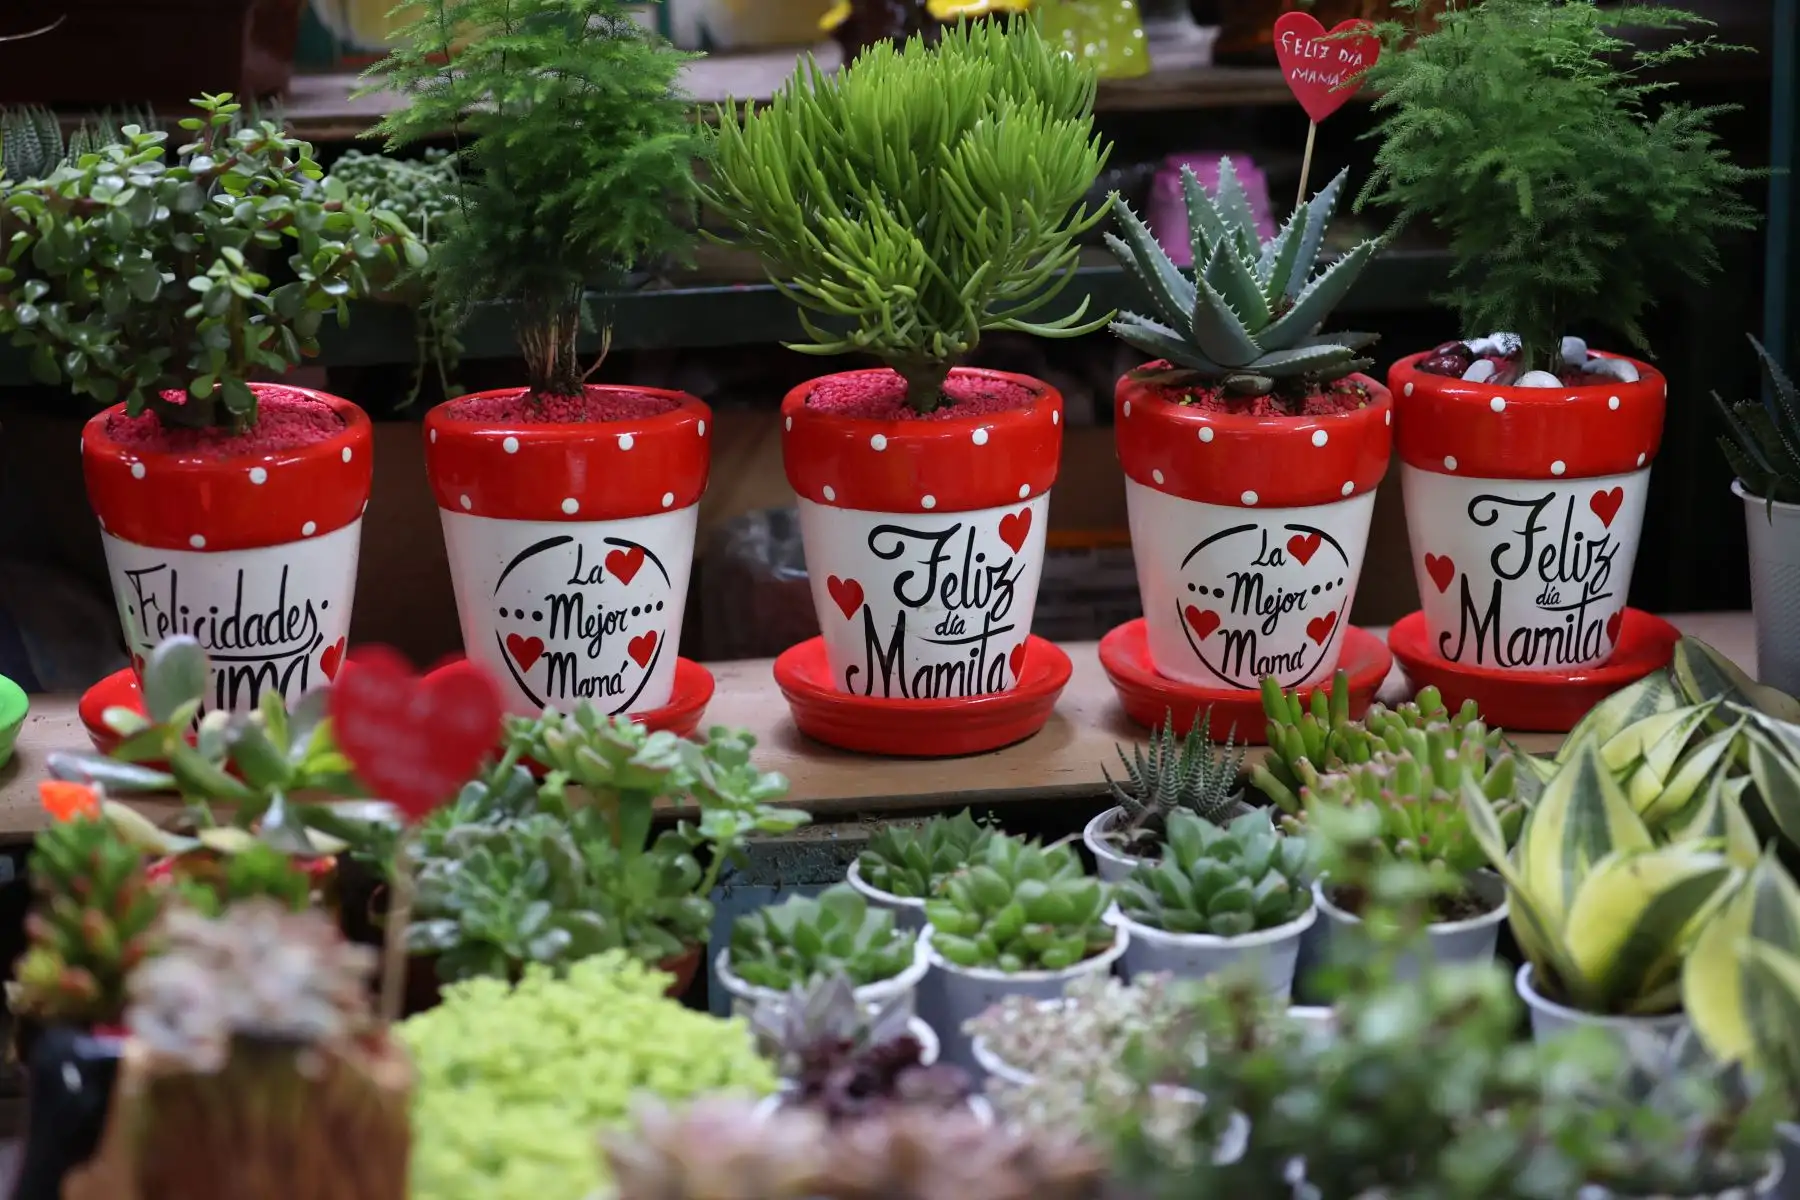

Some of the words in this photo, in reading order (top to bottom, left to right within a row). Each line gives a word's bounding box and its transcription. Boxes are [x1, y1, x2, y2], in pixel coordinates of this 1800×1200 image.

[1281, 31, 1330, 58] FELIZ
[567, 543, 605, 585] La
[1250, 528, 1287, 567] La
[1467, 491, 1621, 595] Feliz
[867, 522, 1026, 622] Feliz
[1535, 583, 1562, 606] día
[125, 564, 318, 656] Felicidades
[544, 592, 628, 659] Mejor
[935, 611, 967, 636] día
[1226, 572, 1308, 636] Mejor
[1439, 573, 1613, 668] Mamita
[541, 652, 629, 699] Mamá
[845, 603, 1015, 699] Mamita
[1218, 629, 1308, 678] Mamá
